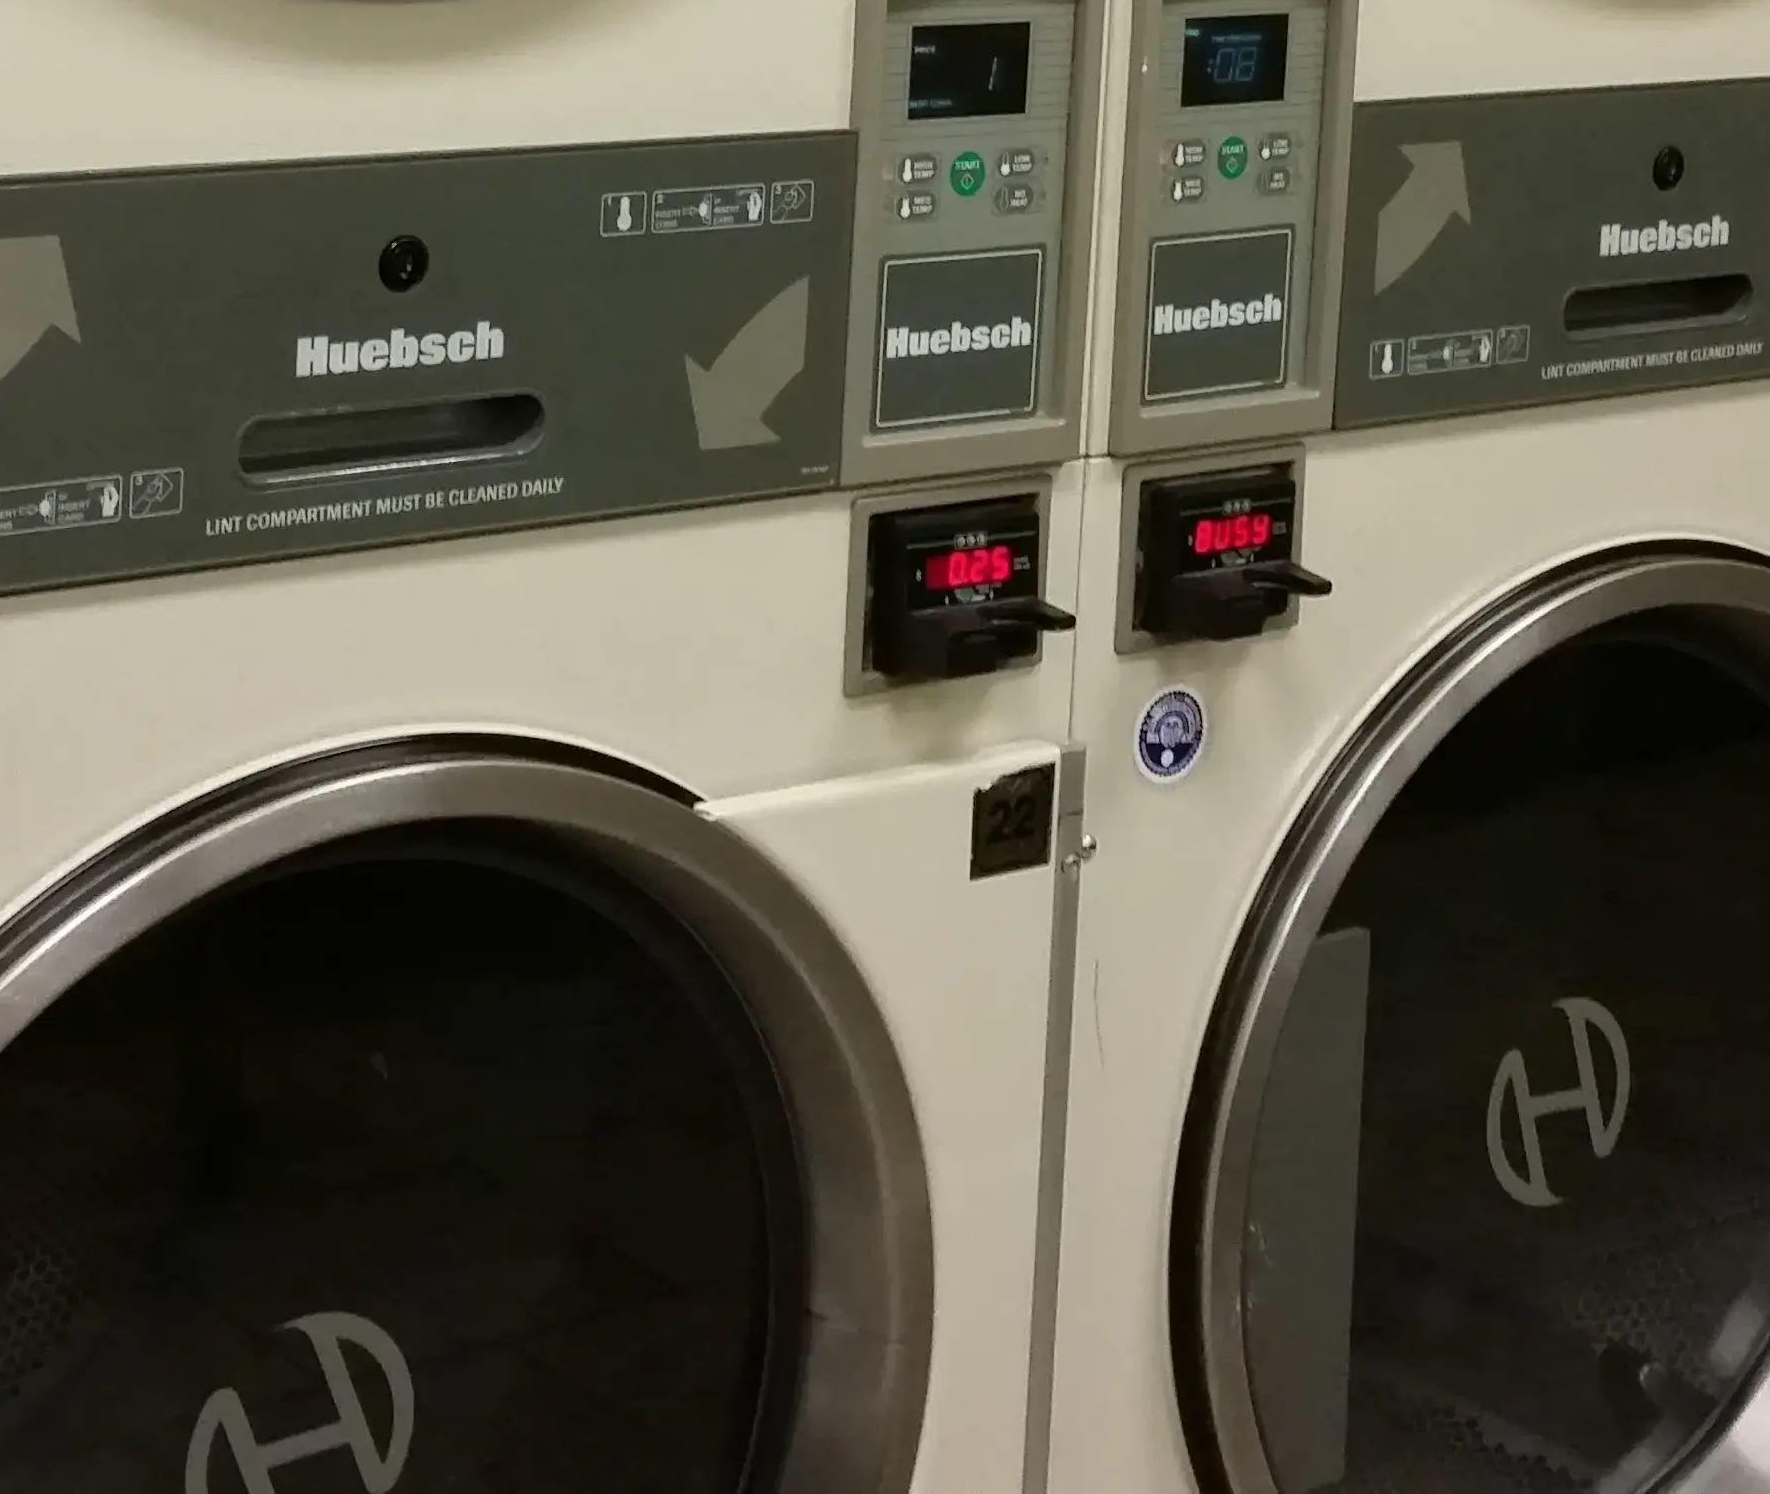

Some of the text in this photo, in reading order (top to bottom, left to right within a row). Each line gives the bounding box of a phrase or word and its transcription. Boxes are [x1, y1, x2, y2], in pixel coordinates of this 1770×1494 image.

[955, 160, 980, 171] START
[1599, 215, 1730, 258] Huebsch
[1154, 292, 1284, 336] Huebsch
[294, 320, 505, 378] Huebsch
[886, 315, 1032, 360] Huebsch
[205, 476, 565, 537] LINT COMPARTMENT MUST BE CLEANED DAILY
[946, 545, 1012, 588] 0.25
[986, 794, 1038, 845] 22
